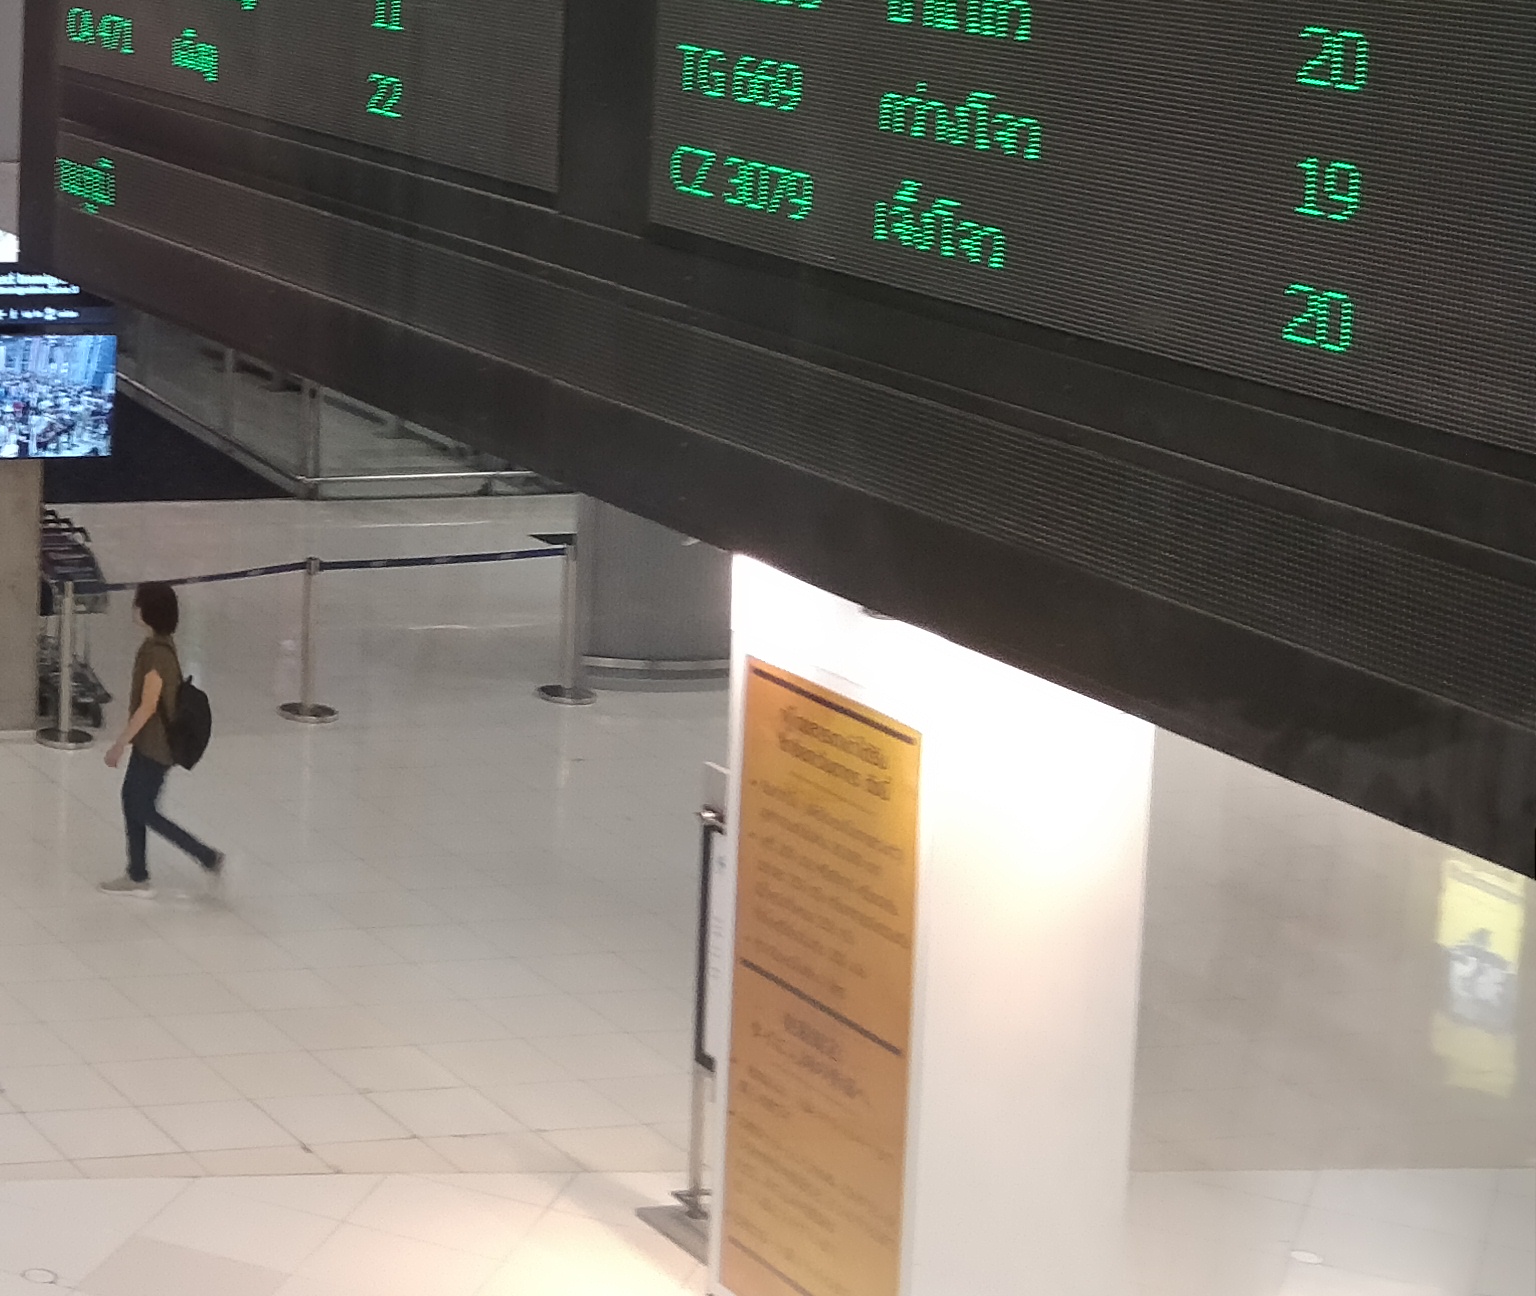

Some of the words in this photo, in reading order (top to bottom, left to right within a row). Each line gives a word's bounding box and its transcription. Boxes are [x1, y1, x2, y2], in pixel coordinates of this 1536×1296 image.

[69, 8, 96, 42] CA
[97, 15, 133, 54] 471
[1297, 26, 1368, 90] 20
[367, 74, 401, 118] 22
[677, 44, 726, 98] TG
[732, 56, 802, 112] 669
[879, 82, 1041, 159] กว่างโจว
[670, 145, 716, 198] CZ
[723, 156, 813, 220] 3079
[1295, 157, 1360, 220] 19
[1282, 284, 1353, 352] 20
